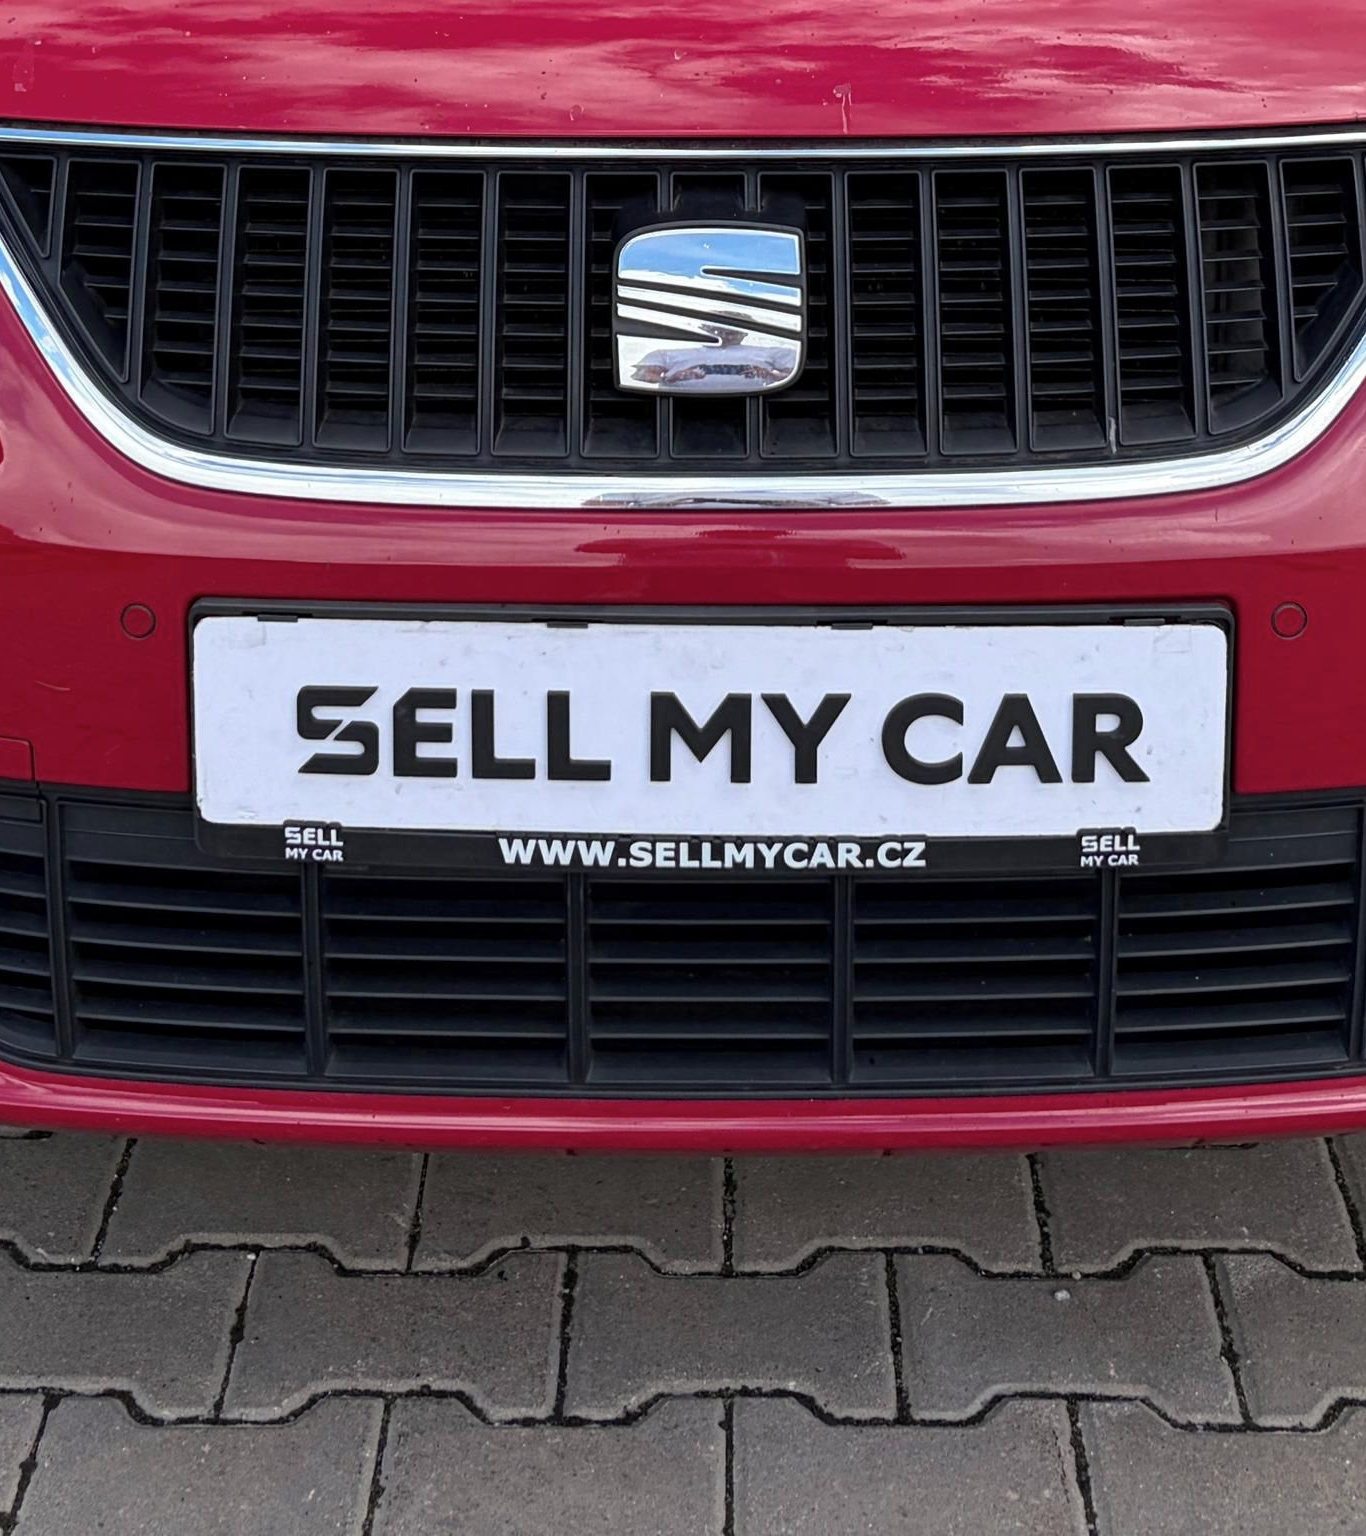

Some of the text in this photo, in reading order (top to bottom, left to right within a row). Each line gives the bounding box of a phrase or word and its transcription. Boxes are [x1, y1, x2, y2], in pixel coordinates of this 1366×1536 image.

[297, 685, 1150, 786] SELL MY CAR
[284, 827, 344, 846] SELL
[1081, 834, 1141, 853] SELL
[285, 847, 344, 862] MY CAR
[498, 838, 926, 869] WWW.SELLMYCAR.CZ
[1080, 854, 1139, 867] MY CAR
